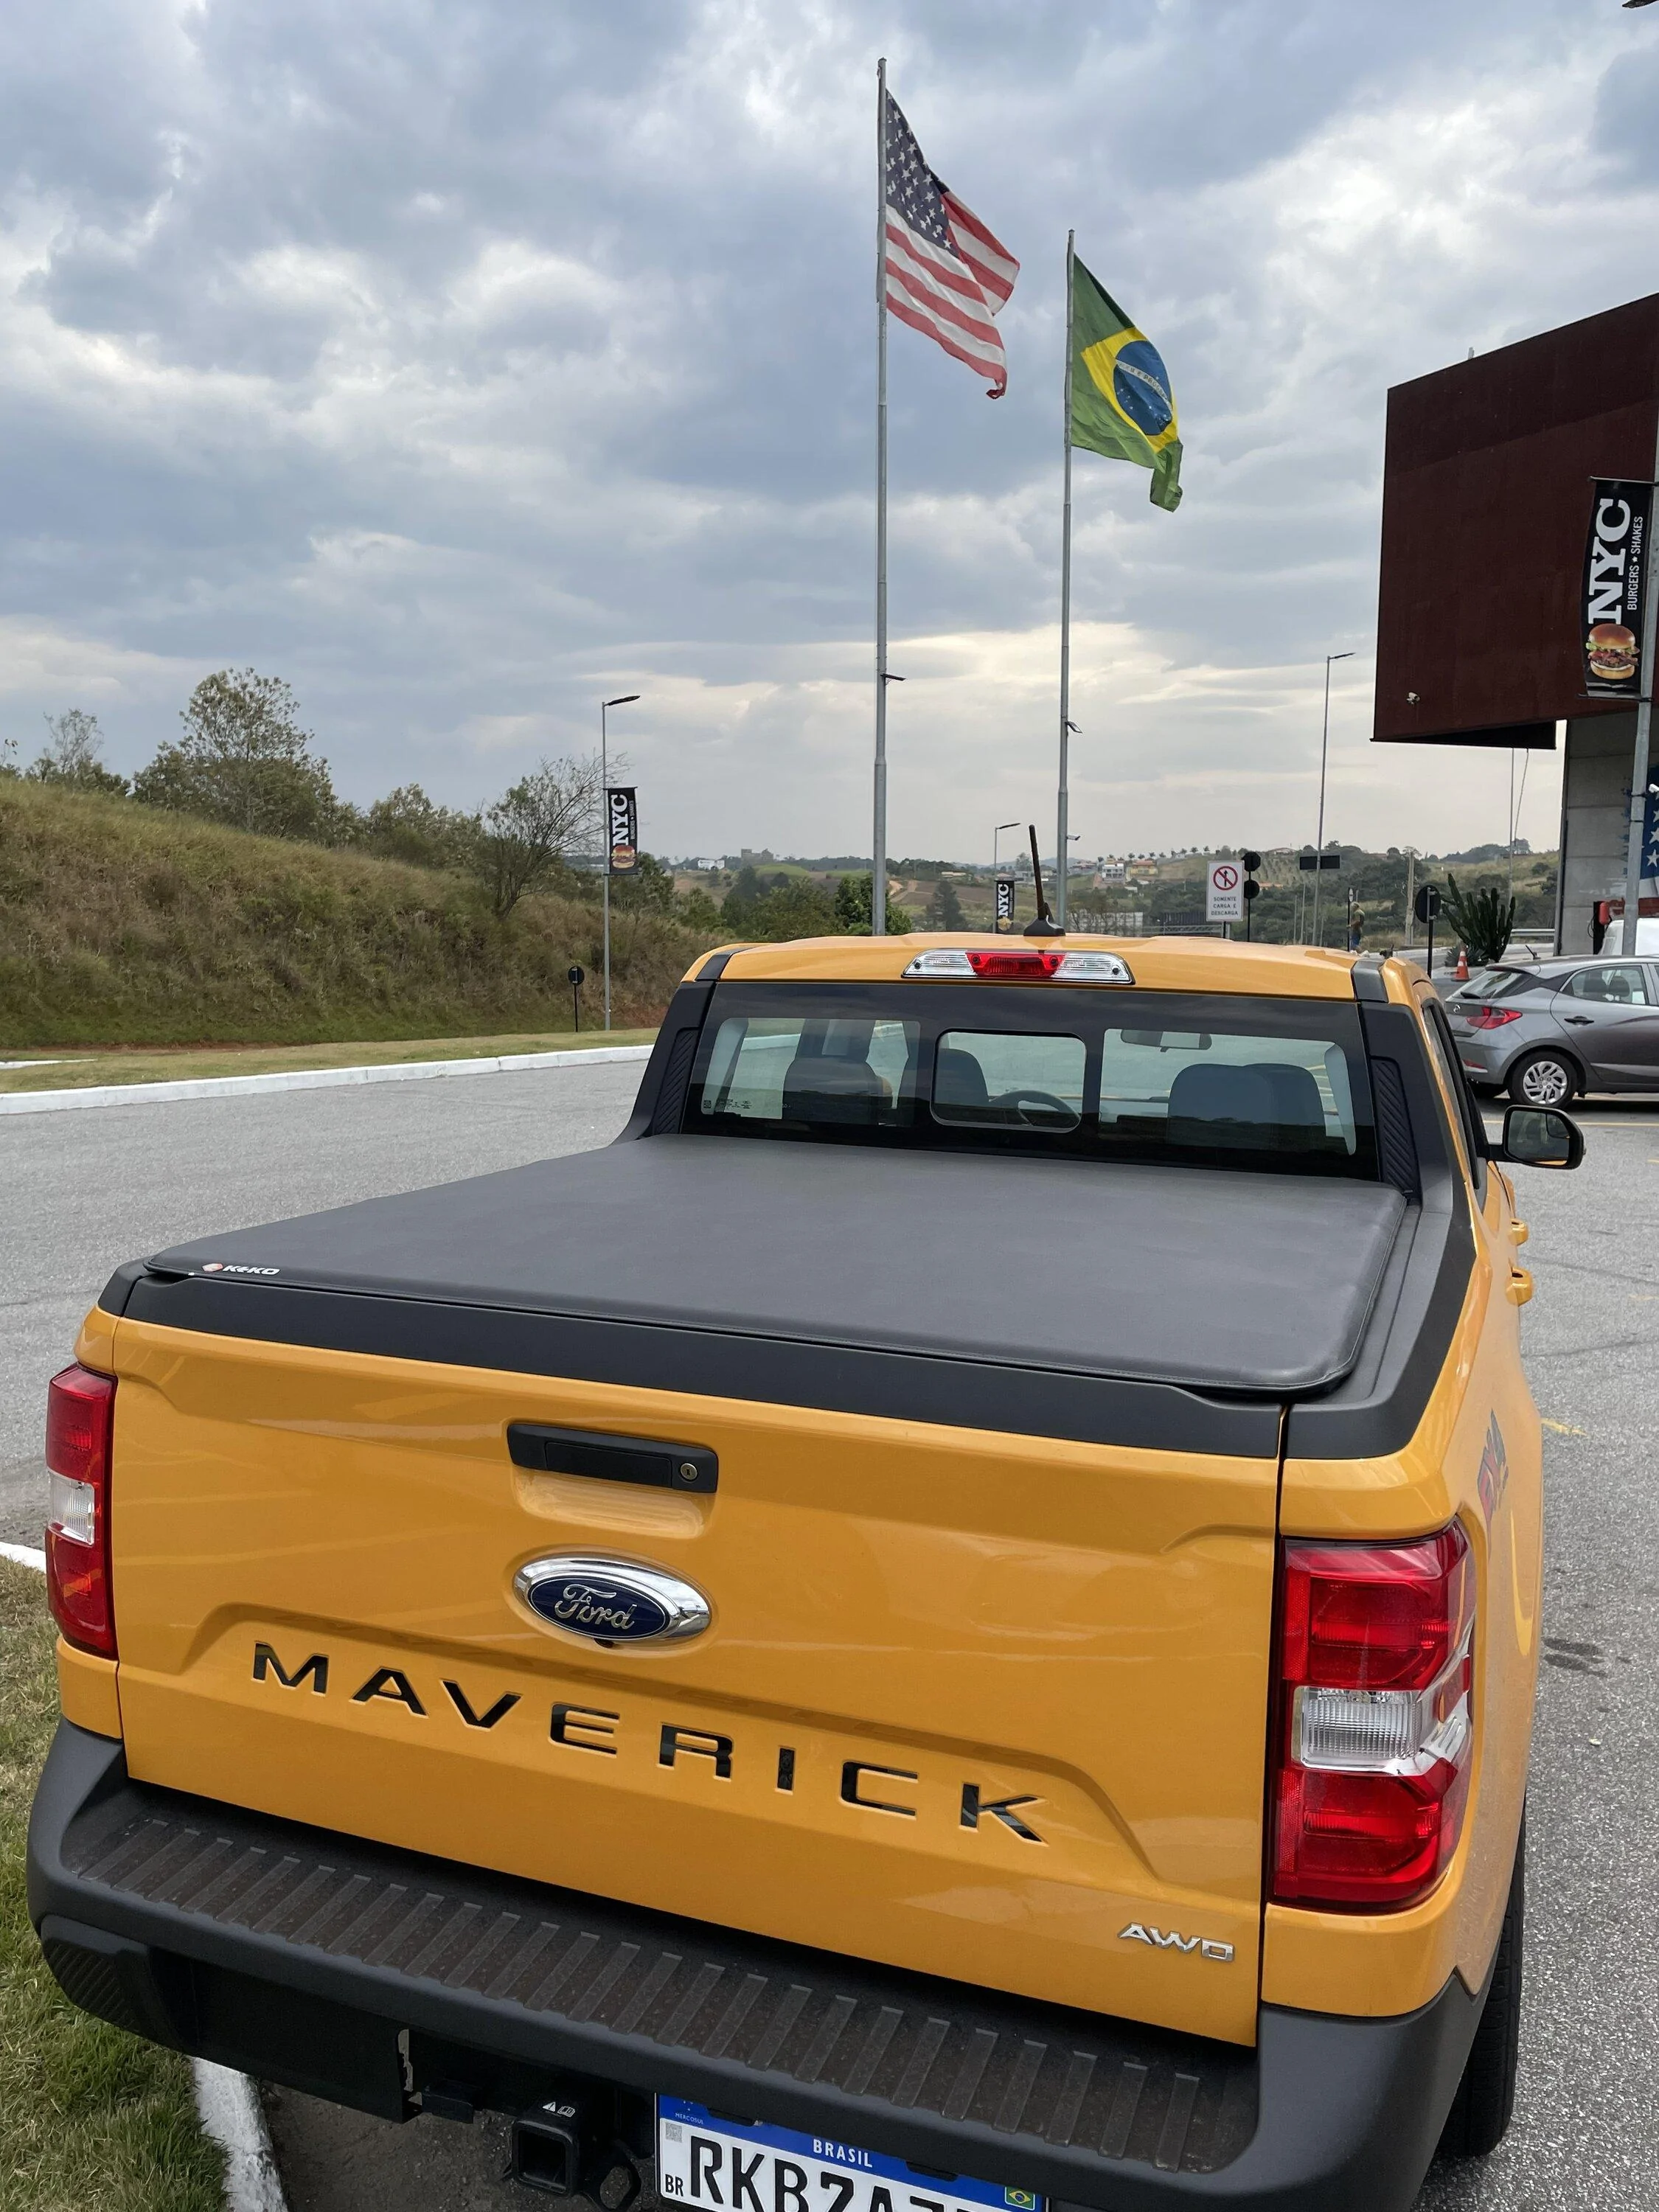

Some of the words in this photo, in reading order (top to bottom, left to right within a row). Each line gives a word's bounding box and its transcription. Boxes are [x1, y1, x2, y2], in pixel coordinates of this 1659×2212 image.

[1631, 516, 1643, 554] SHAKES
[1588, 498, 1630, 625] NYC
[1627, 565, 1639, 611] BURGERS
[611, 794, 629, 846] NYC
[998, 884, 1009, 917] NYC
[554, 1584, 638, 1630] Ford
[253, 1642, 1049, 1846] MAVERICK
[1117, 1922, 1235, 1962] AWD
[675, 2112, 704, 2125] MERCOSUL
[813, 2139, 873, 2168] BRASIL
[665, 2174, 684, 2197] BR
